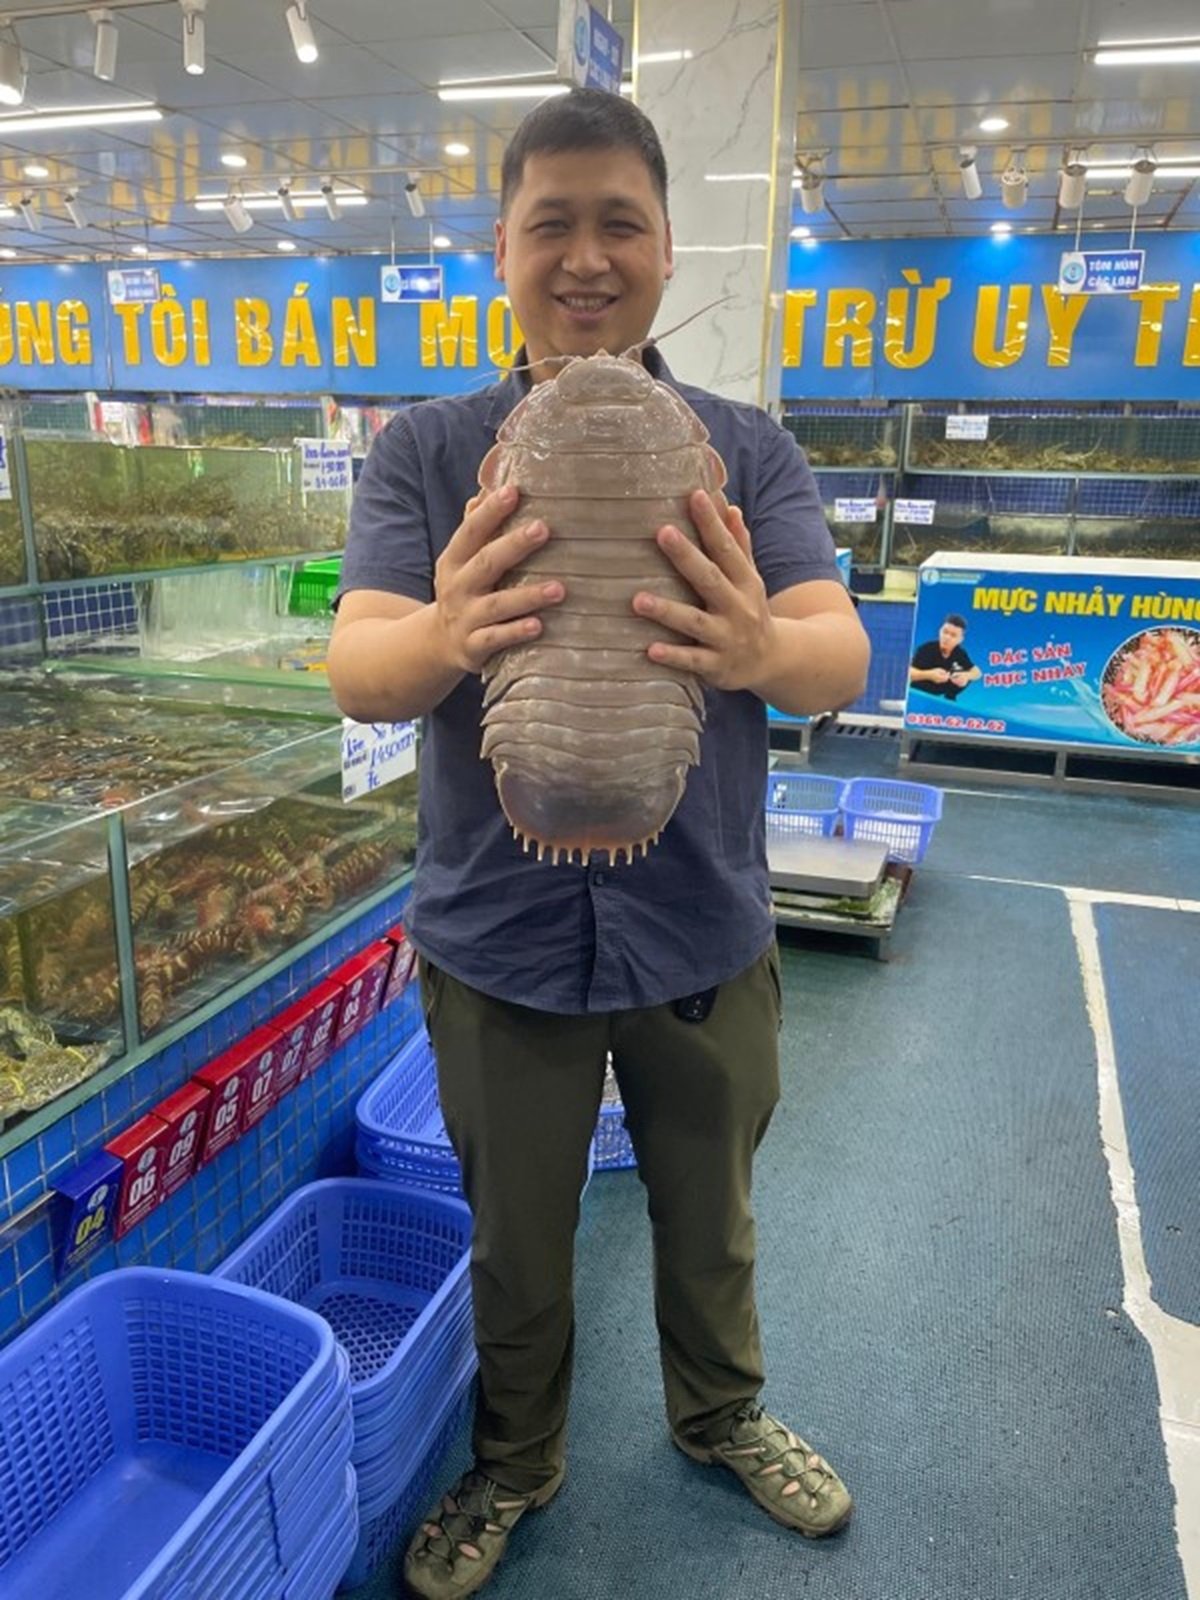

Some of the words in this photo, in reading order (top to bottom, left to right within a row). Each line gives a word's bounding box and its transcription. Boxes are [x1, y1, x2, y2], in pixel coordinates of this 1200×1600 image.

[114, 283, 211, 367] TÔI
[235, 282, 377, 367] BÁN
[783, 269, 951, 369] TRỪ
[972, 284, 1090, 368] UY
[973, 587, 1038, 616] MỰC
[1044, 586, 1125, 617] NHẢY
[251, 1068, 273, 1103] 07
[214, 1096, 239, 1132] 05
[169, 1130, 195, 1167] 09
[129, 1167, 156, 1206] 06
[75, 1205, 105, 1245] 04
